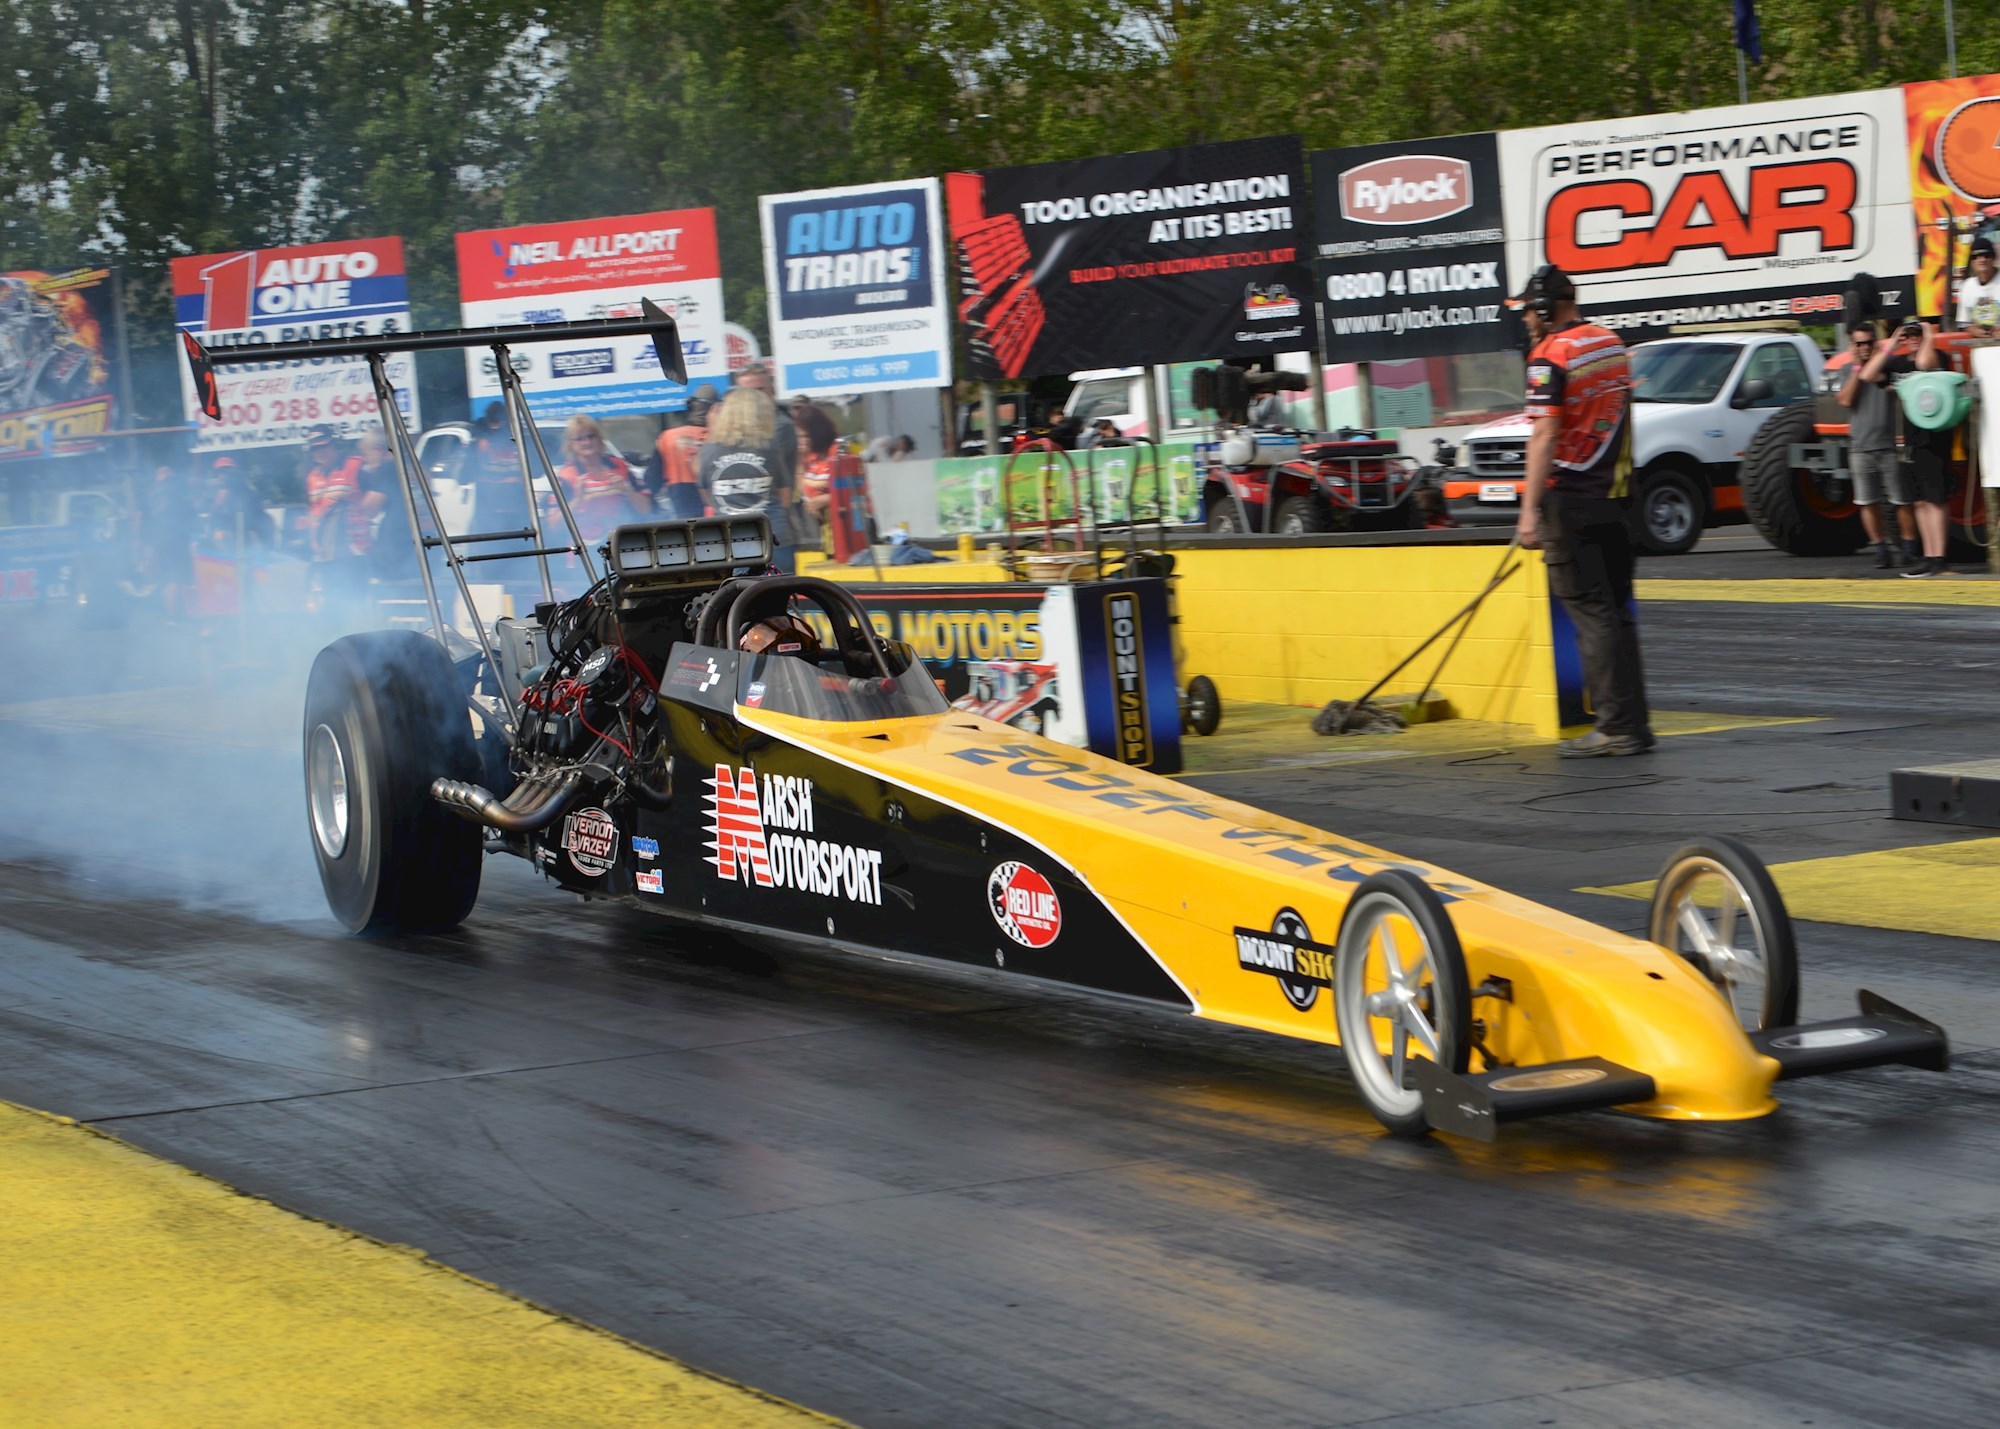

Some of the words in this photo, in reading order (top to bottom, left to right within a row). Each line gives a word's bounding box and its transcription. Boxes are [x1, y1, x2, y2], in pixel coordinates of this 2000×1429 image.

[1549, 125, 1862, 178] PERFORMANCE
[1021, 197, 1091, 225] TOOL
[1090, 174, 1291, 218] ORGANISATION
[1352, 172, 1459, 214] Rylock
[786, 201, 916, 256] AUTO
[1148, 218, 1182, 244] AT
[1183, 213, 1224, 240] ITS
[1225, 206, 1293, 237] BEST!
[1544, 157, 1857, 275] CAR
[508, 240, 566, 267] NEIL
[568, 228, 683, 260] ALLPORT
[1763, 254, 1838, 270] Magazine
[257, 250, 379, 288] AUTO
[784, 246, 913, 293] TRANS
[1326, 271, 1387, 301] 0800
[1387, 269, 1408, 296] 4
[1407, 261, 1500, 295] RYLOCK
[258, 279, 352, 314] ONE
[204, 371, 218, 415] 2
[272, 397, 321, 422] 288
[898, 610, 1043, 662] MOTORS
[1111, 599, 1140, 692] MOUNT
[581, 657, 606, 674] MSD
[1120, 691, 1145, 761] SHOP
[572, 815, 614, 840] VERNON
[577, 834, 611, 857] VAZEY
[1008, 886, 1032, 917] RED
[1031, 890, 1058, 922] LINE
[1234, 933, 1295, 973] MOUNT
